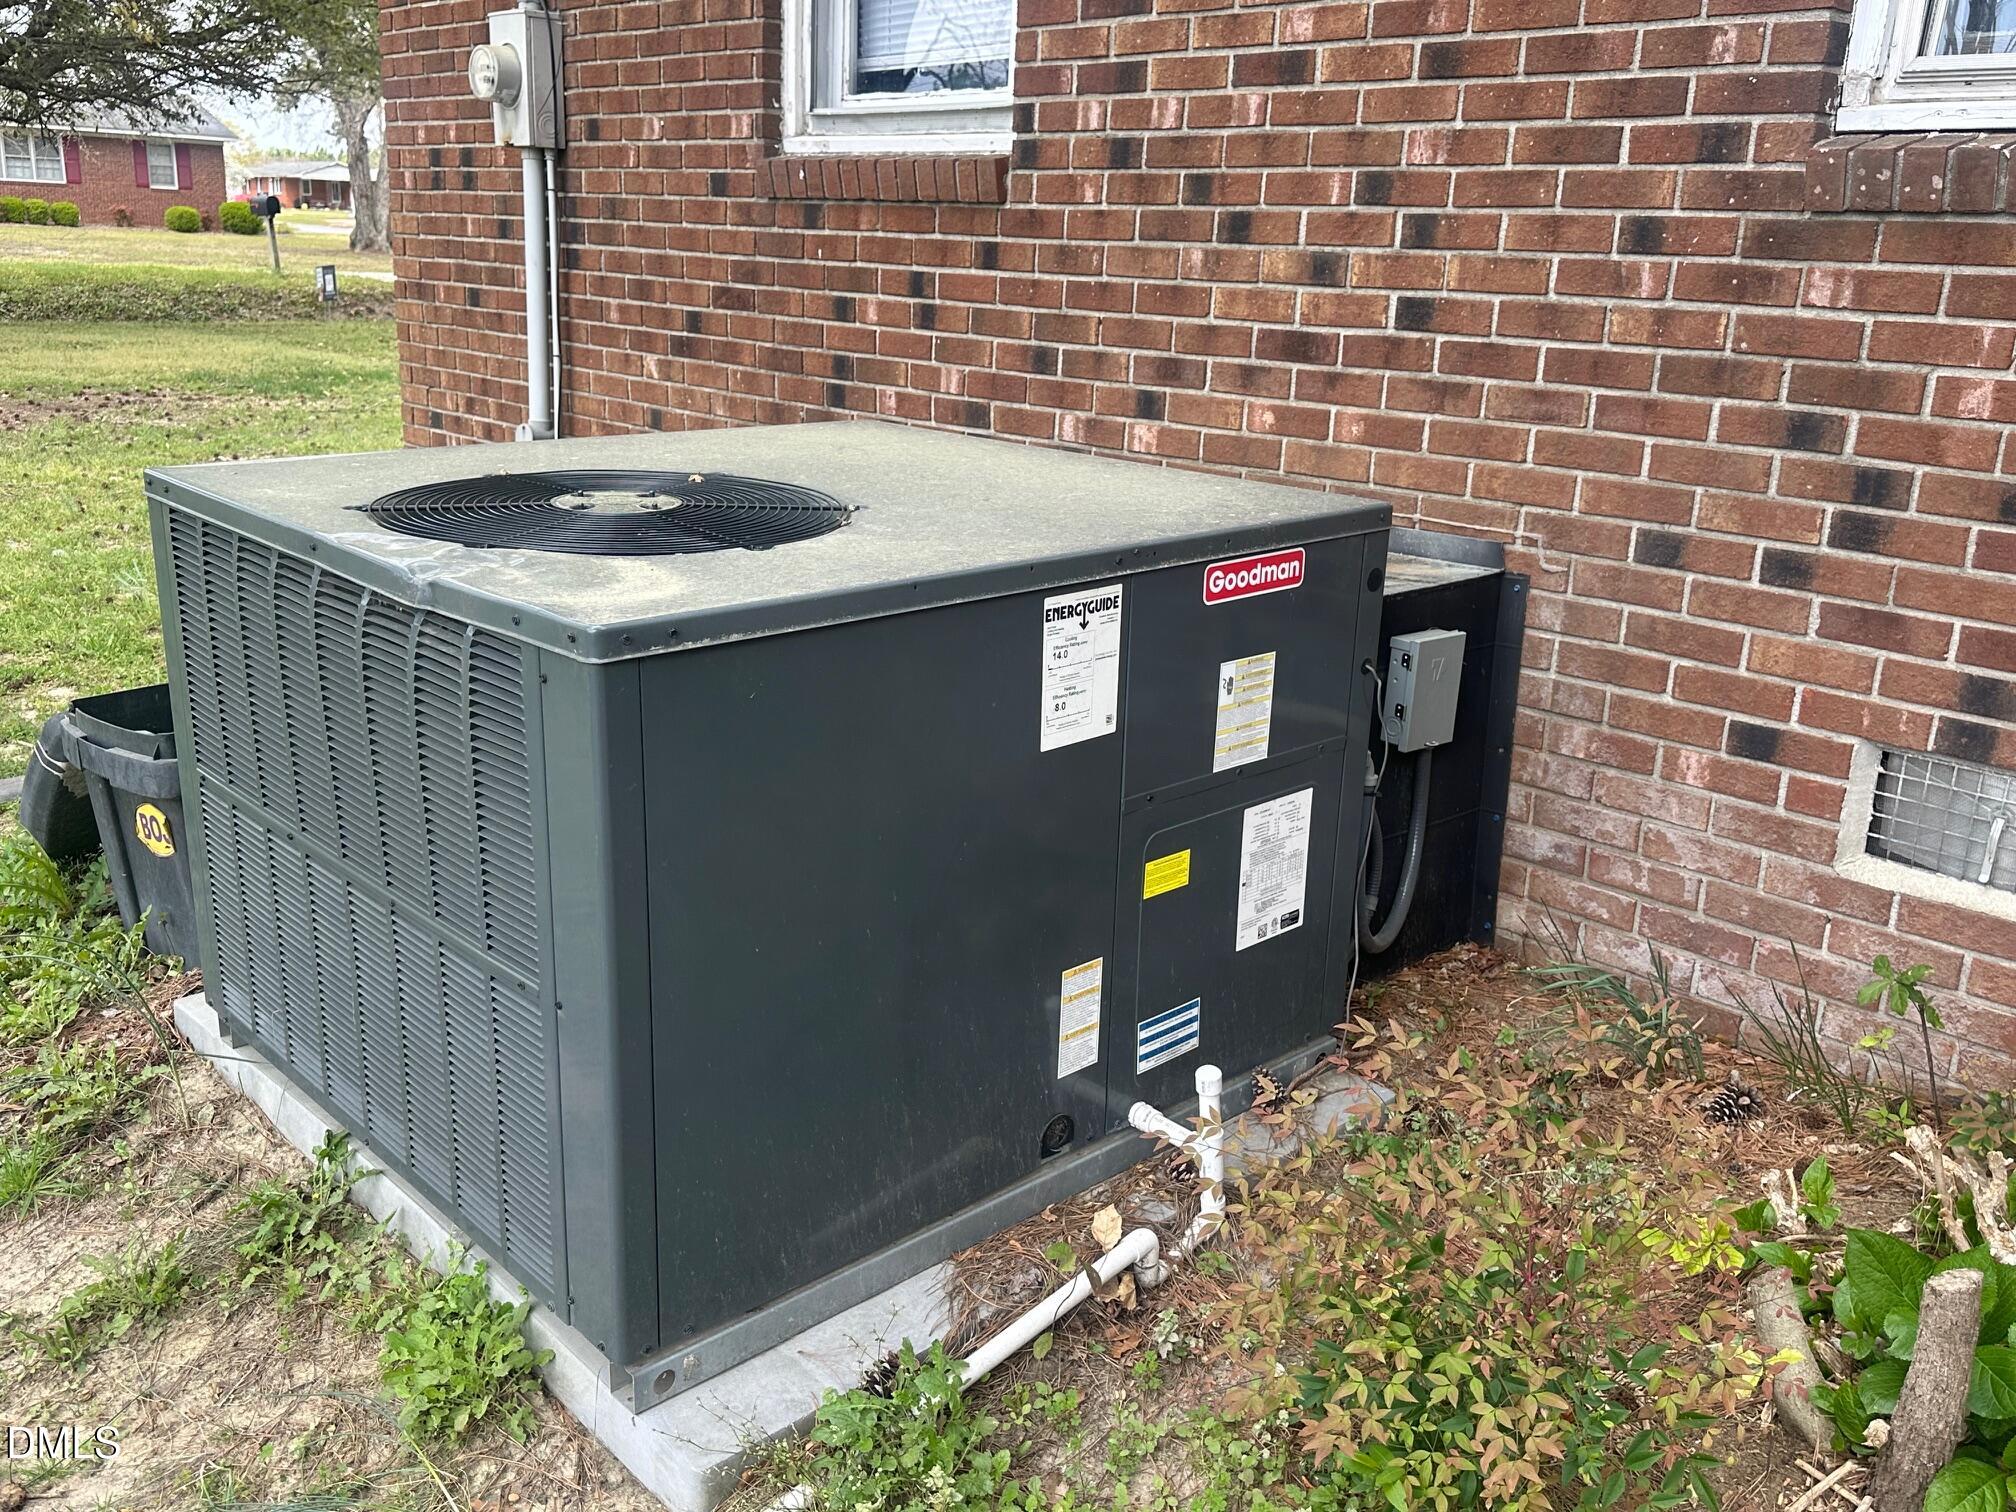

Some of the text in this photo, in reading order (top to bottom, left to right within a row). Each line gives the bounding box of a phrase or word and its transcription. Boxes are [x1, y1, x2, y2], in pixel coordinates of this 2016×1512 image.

[1209, 559, 1300, 594] Goodman
[1045, 595, 1120, 628] ENERGYGUIDE
[1053, 650, 1069, 661] 14.0
[1054, 701, 1066, 712] 8.0
